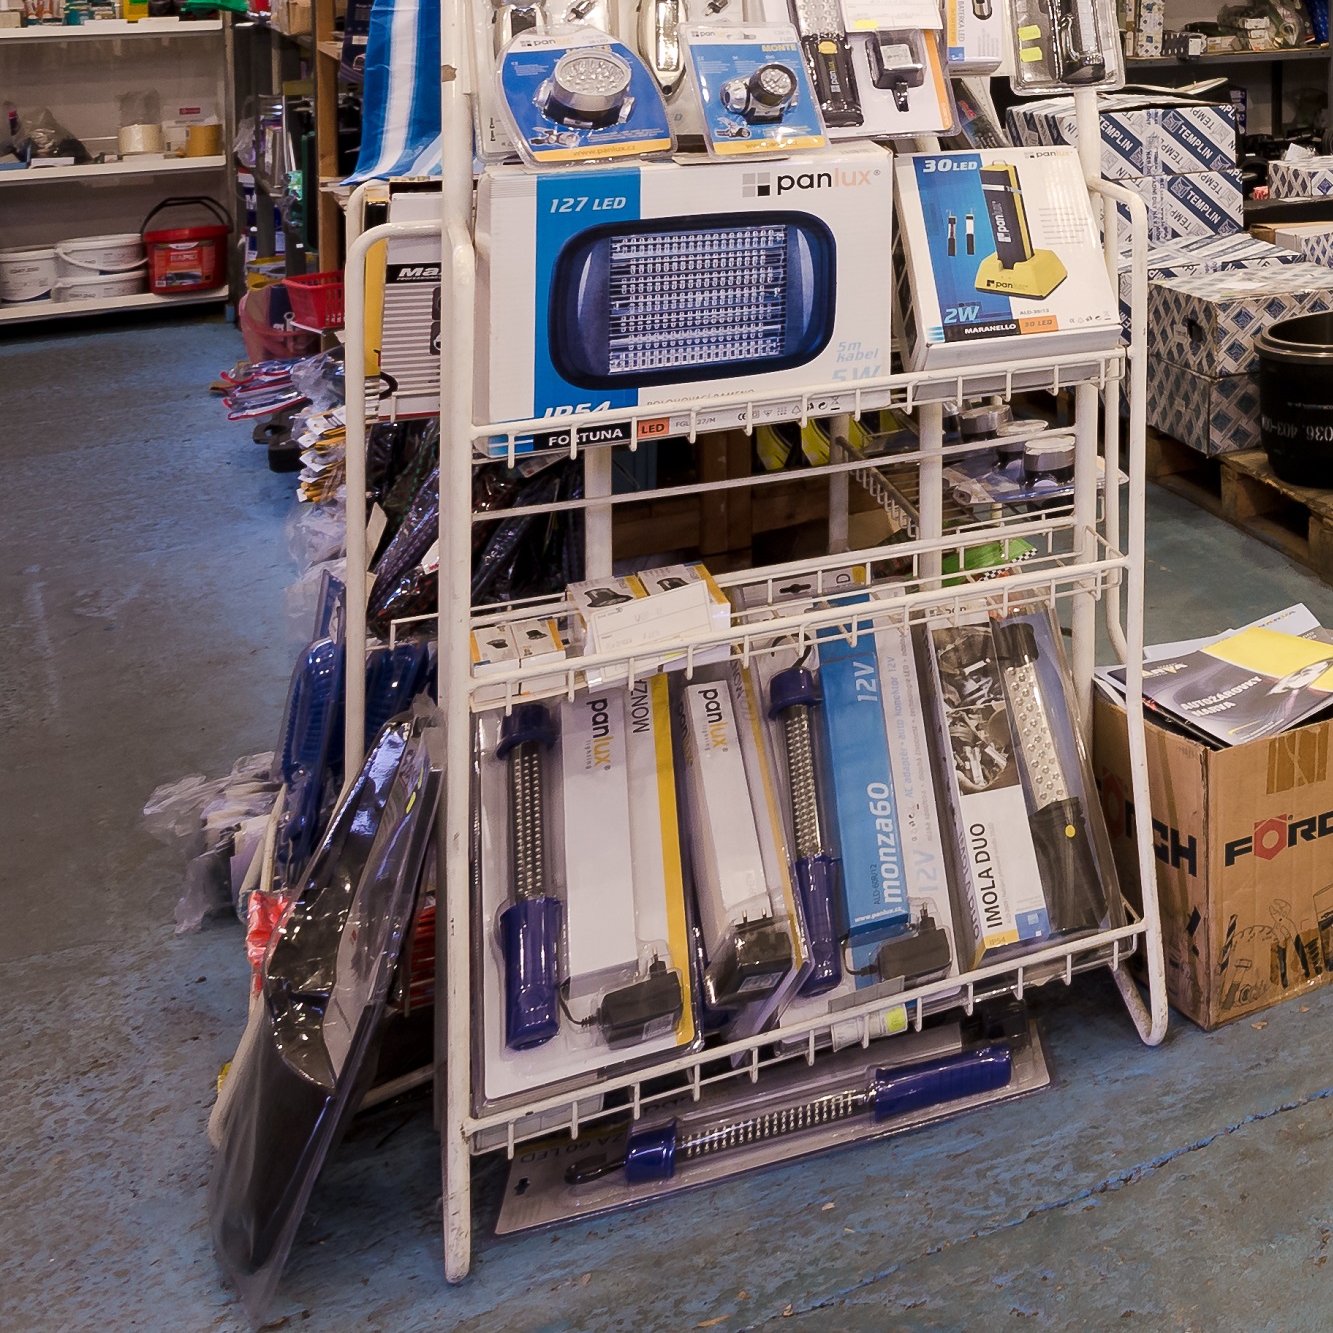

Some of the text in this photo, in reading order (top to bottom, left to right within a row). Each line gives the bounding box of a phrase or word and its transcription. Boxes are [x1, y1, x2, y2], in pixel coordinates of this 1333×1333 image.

[1178, 126, 1213, 159] TEMPLIN
[549, 196, 627, 214] 127 LED
[1186, 190, 1221, 224] TEMPLIN
[945, 305, 981, 324] 2W
[1040, 319, 1053, 328] LED
[964, 322, 1017, 335] MARANELLO
[836, 341, 861, 353] 5m
[836, 348, 879, 364] kabel
[641, 422, 666, 435] LED
[853, 661, 878, 703] 12V
[1181, 674, 1263, 711] AUTOŽÁROVKY
[1191, 699, 1237, 718] NARVA
[866, 781, 902, 905] monza60
[969, 822, 989, 863] DUO
[916, 849, 940, 897] 12V
[979, 865, 1003, 929] IMOLA
